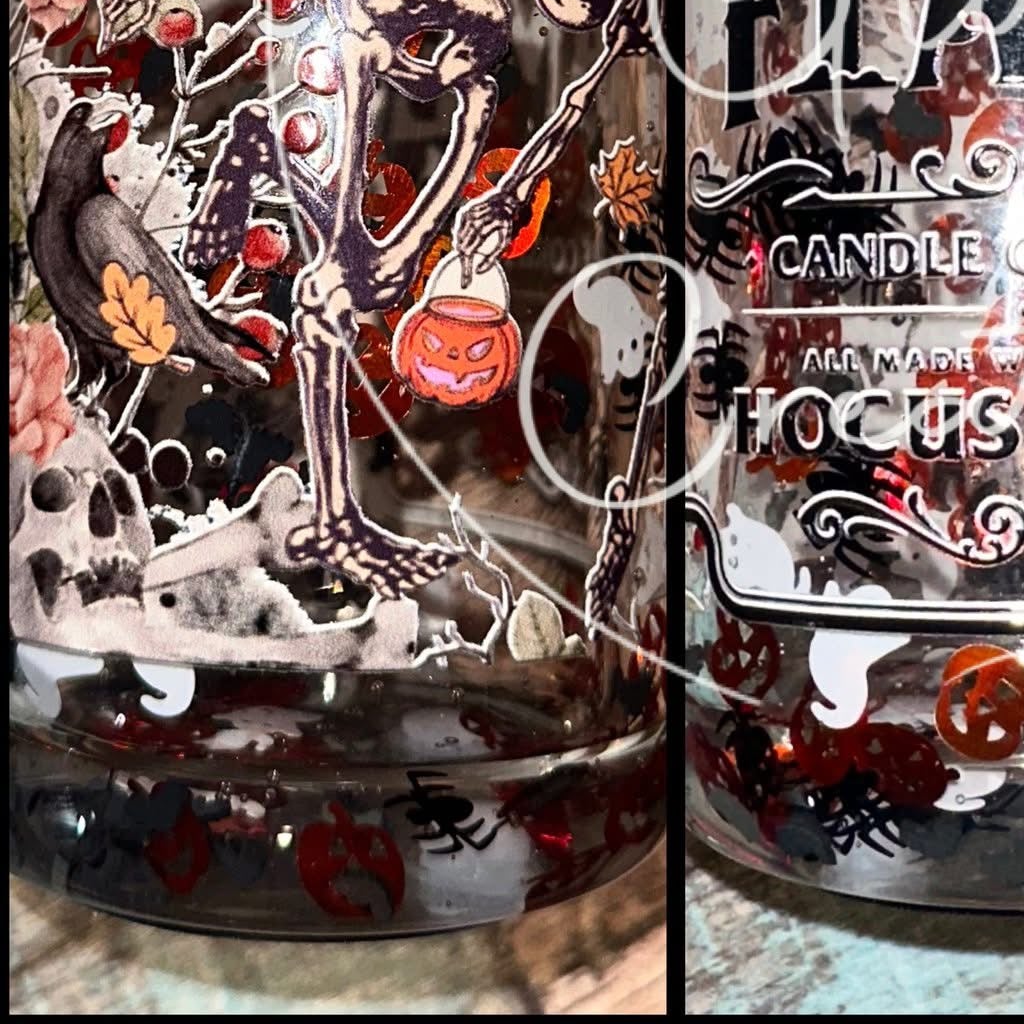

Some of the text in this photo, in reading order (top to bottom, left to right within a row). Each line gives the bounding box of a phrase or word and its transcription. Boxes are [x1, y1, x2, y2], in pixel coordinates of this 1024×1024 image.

[768, 230, 983, 279] CANDLE
[802, 346, 859, 373] ALL
[872, 345, 975, 374] MADE
[732, 384, 1021, 461] HOCUS
